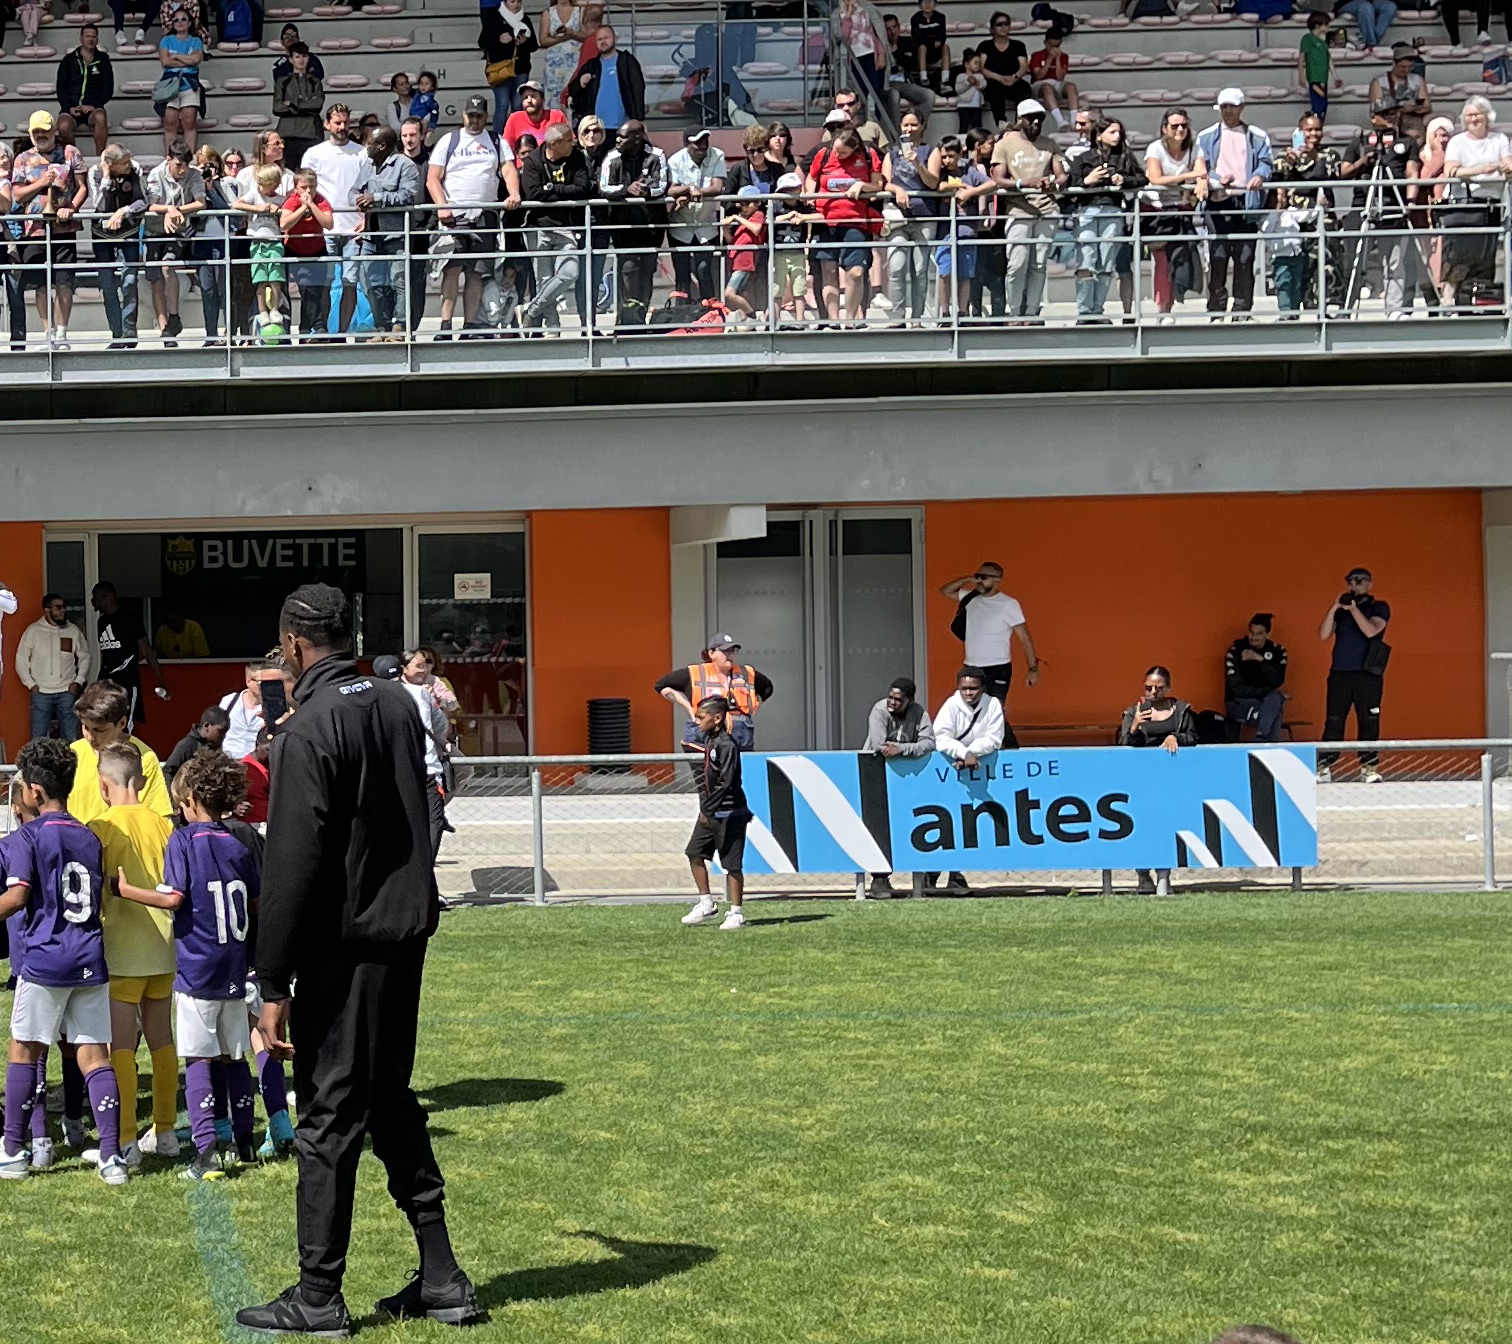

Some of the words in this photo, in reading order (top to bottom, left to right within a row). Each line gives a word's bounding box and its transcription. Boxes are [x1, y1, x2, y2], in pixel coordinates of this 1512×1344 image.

[445, 105, 457, 116] G
[202, 537, 357, 569] BUVETTE
[936, 763, 1014, 783] VILLE
[1027, 760, 1060, 778] DE
[61, 861, 91, 924] 9
[207, 879, 249, 945] 10
